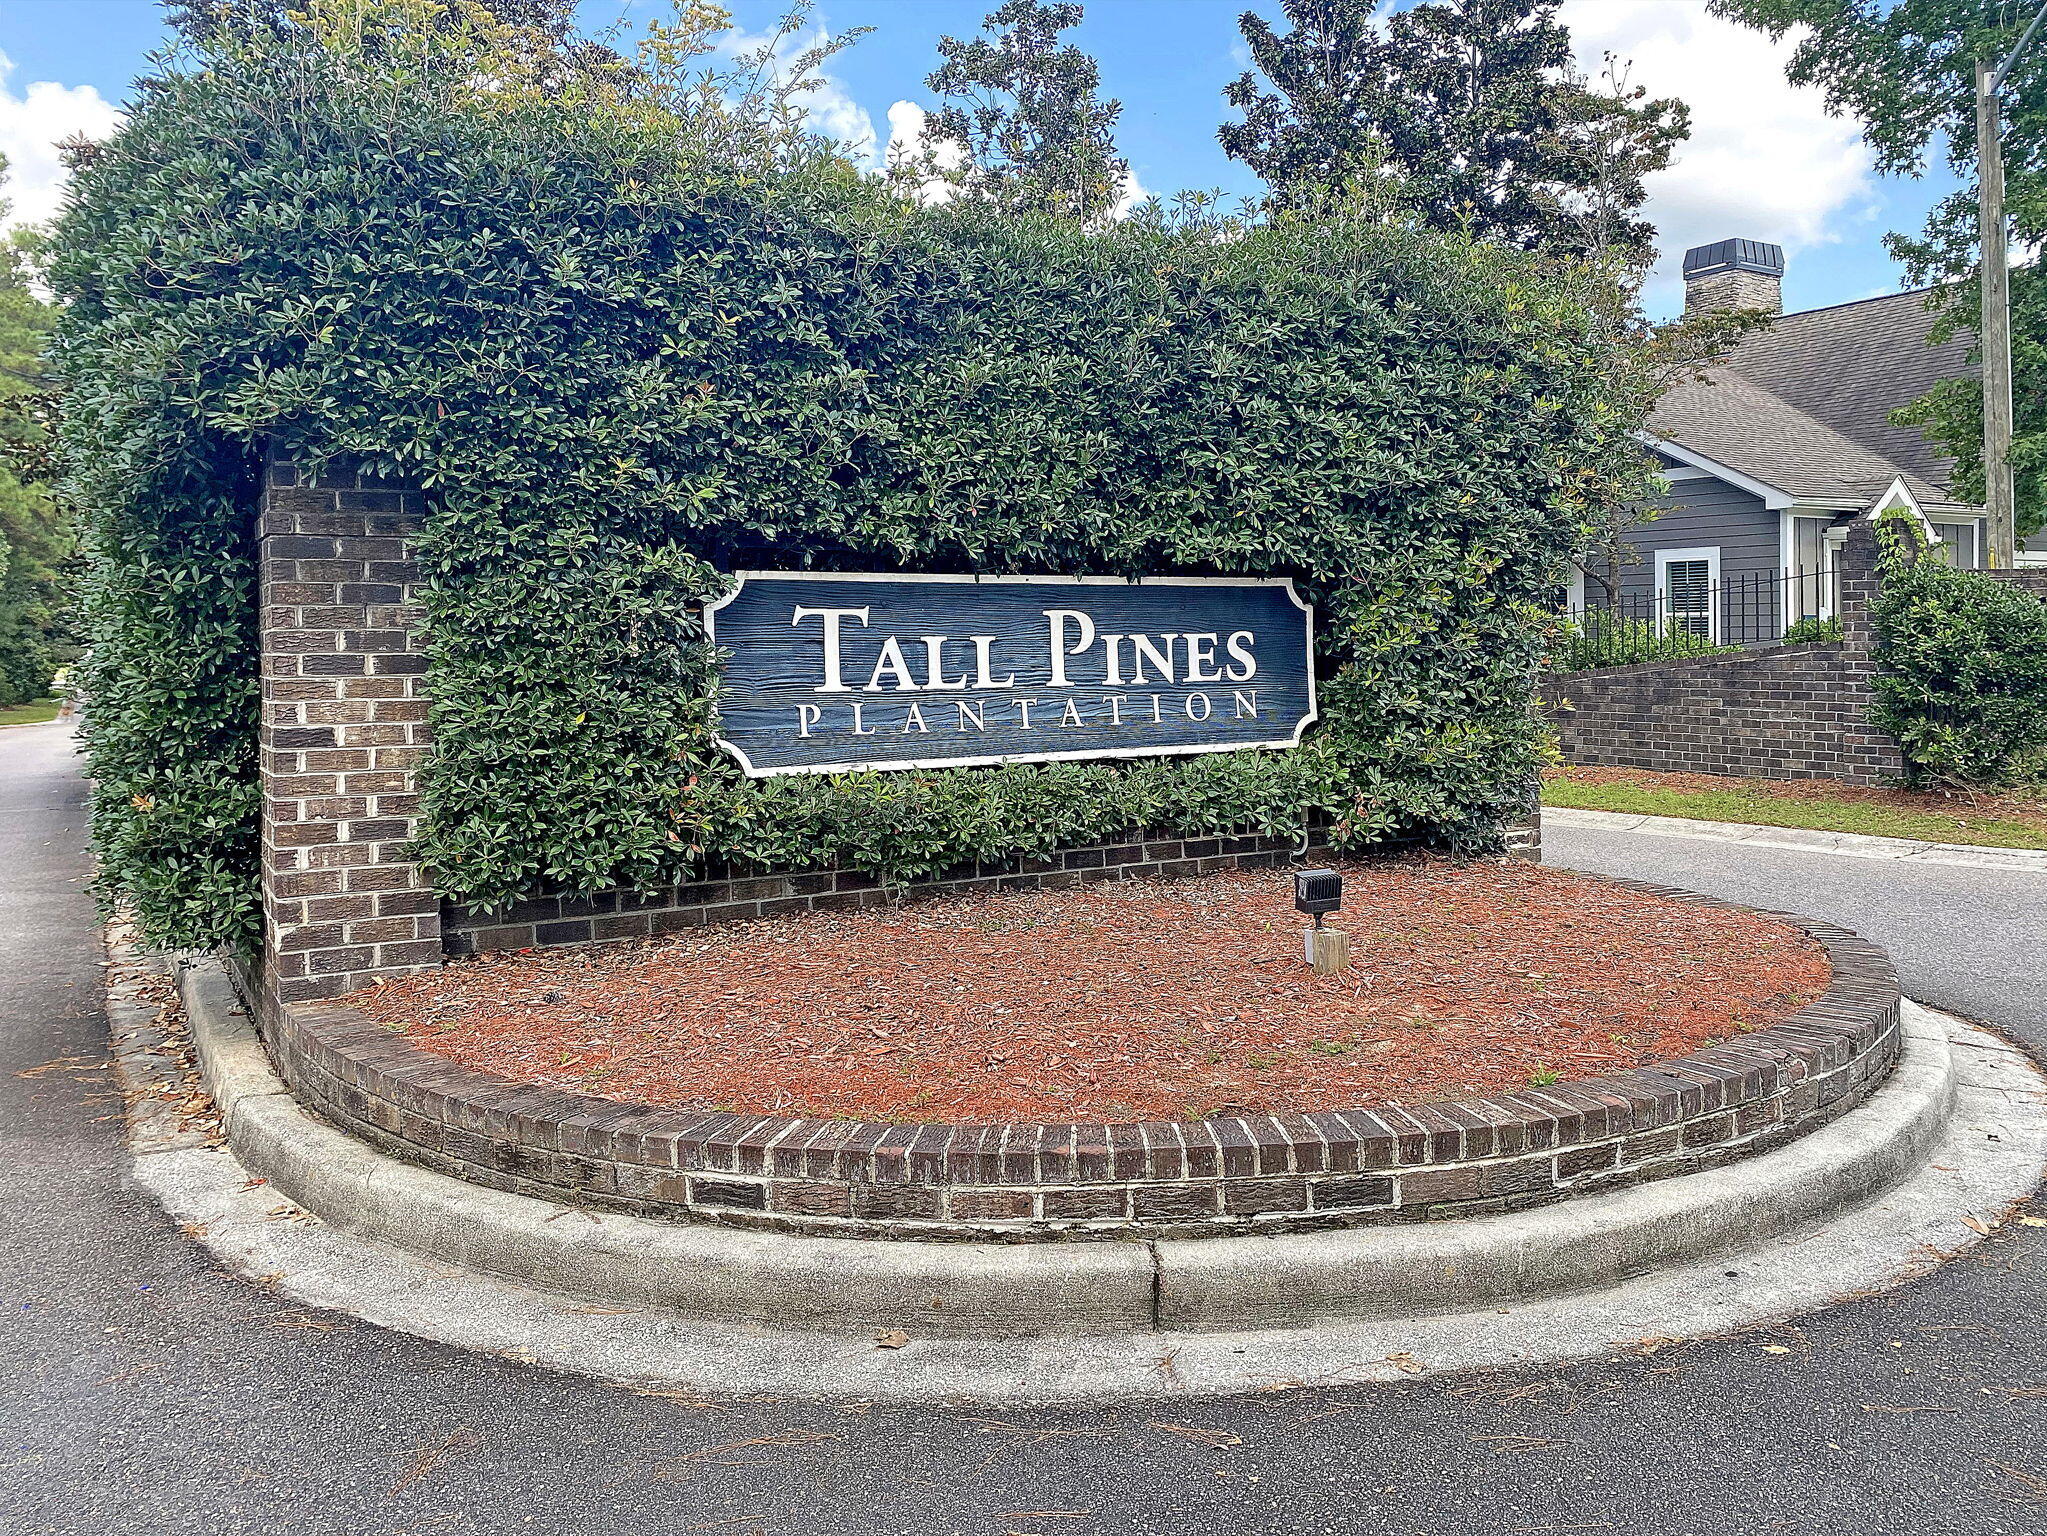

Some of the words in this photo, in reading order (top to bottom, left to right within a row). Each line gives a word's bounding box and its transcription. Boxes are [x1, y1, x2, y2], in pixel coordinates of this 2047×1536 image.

[792, 605, 1015, 693] TALL
[1043, 609, 1257, 688] PINES
[798, 690, 1258, 738] PLANTATION
